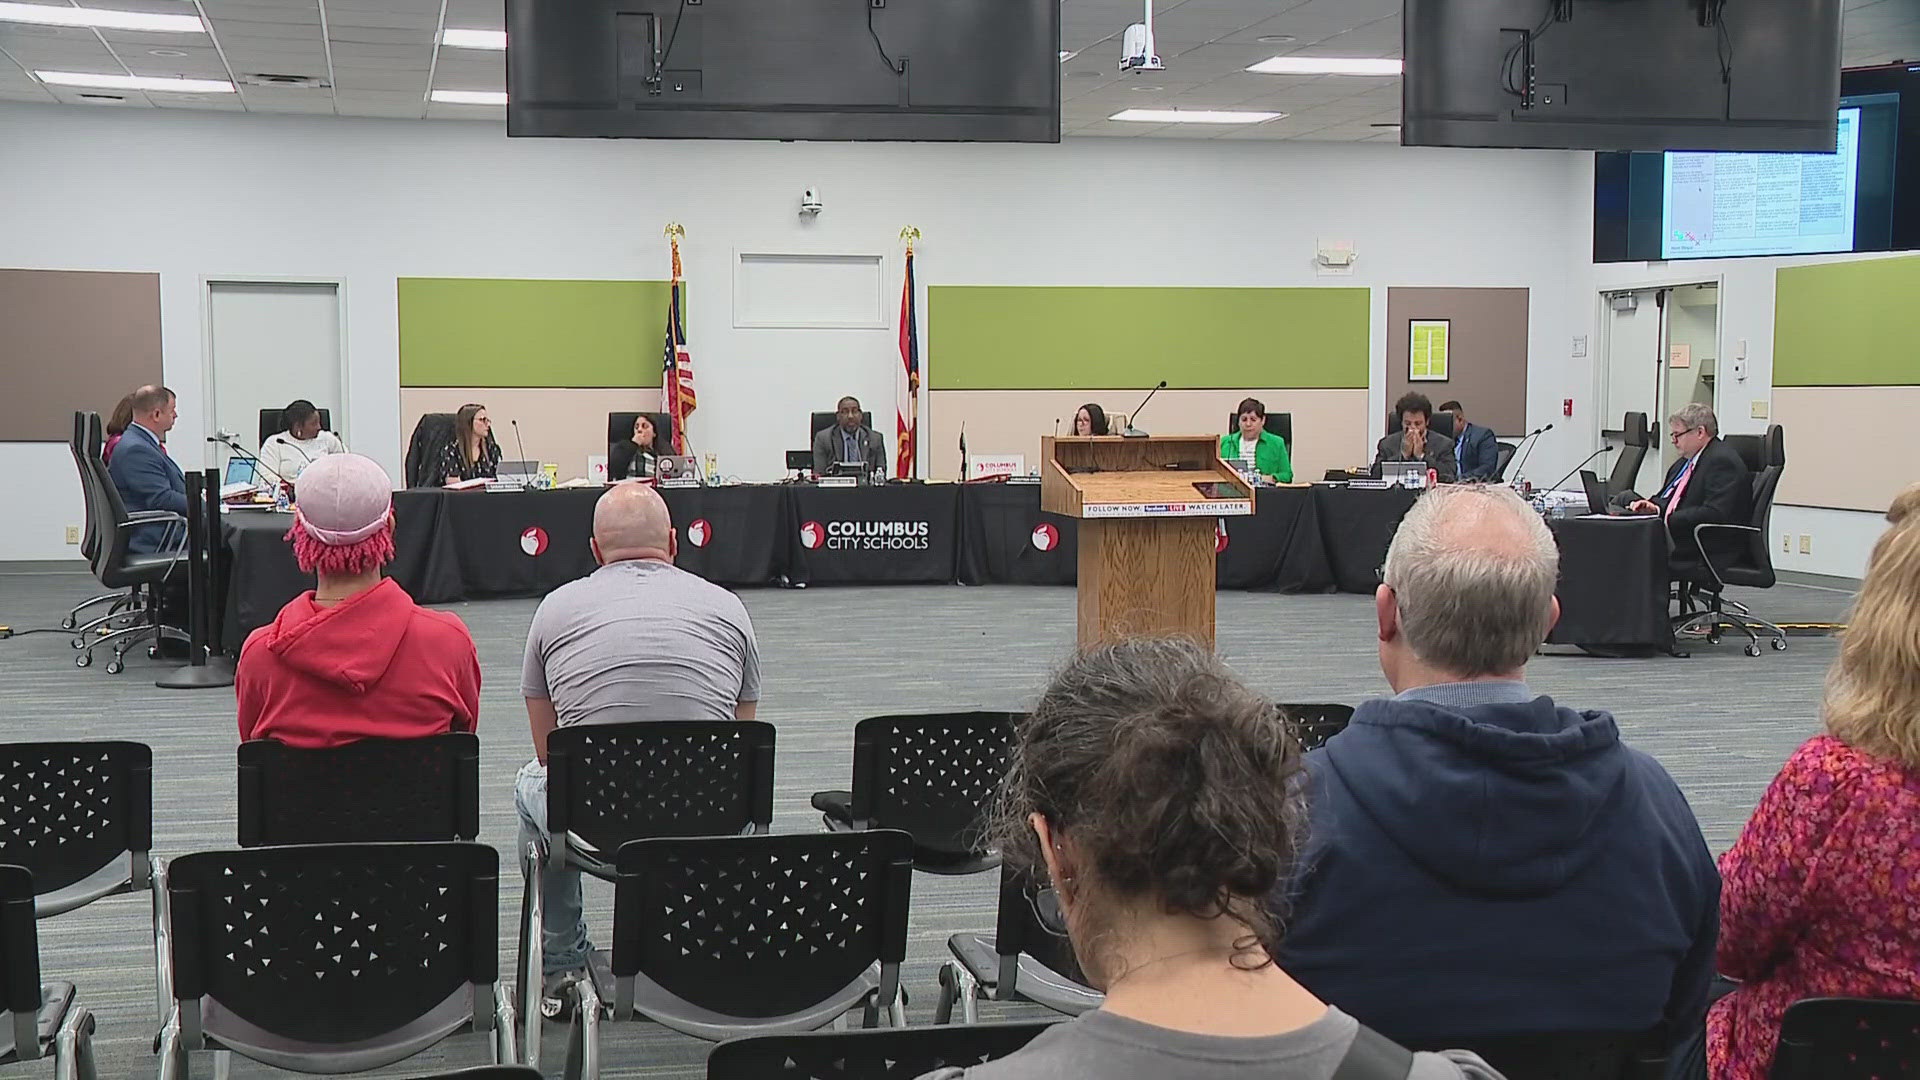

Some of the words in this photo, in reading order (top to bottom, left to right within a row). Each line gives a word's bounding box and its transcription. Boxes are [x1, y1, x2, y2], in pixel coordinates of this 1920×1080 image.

[827, 521, 929, 536] COLUMBUS
[827, 537, 861, 550] CITY
[863, 537, 929, 550] SCHOOLS
